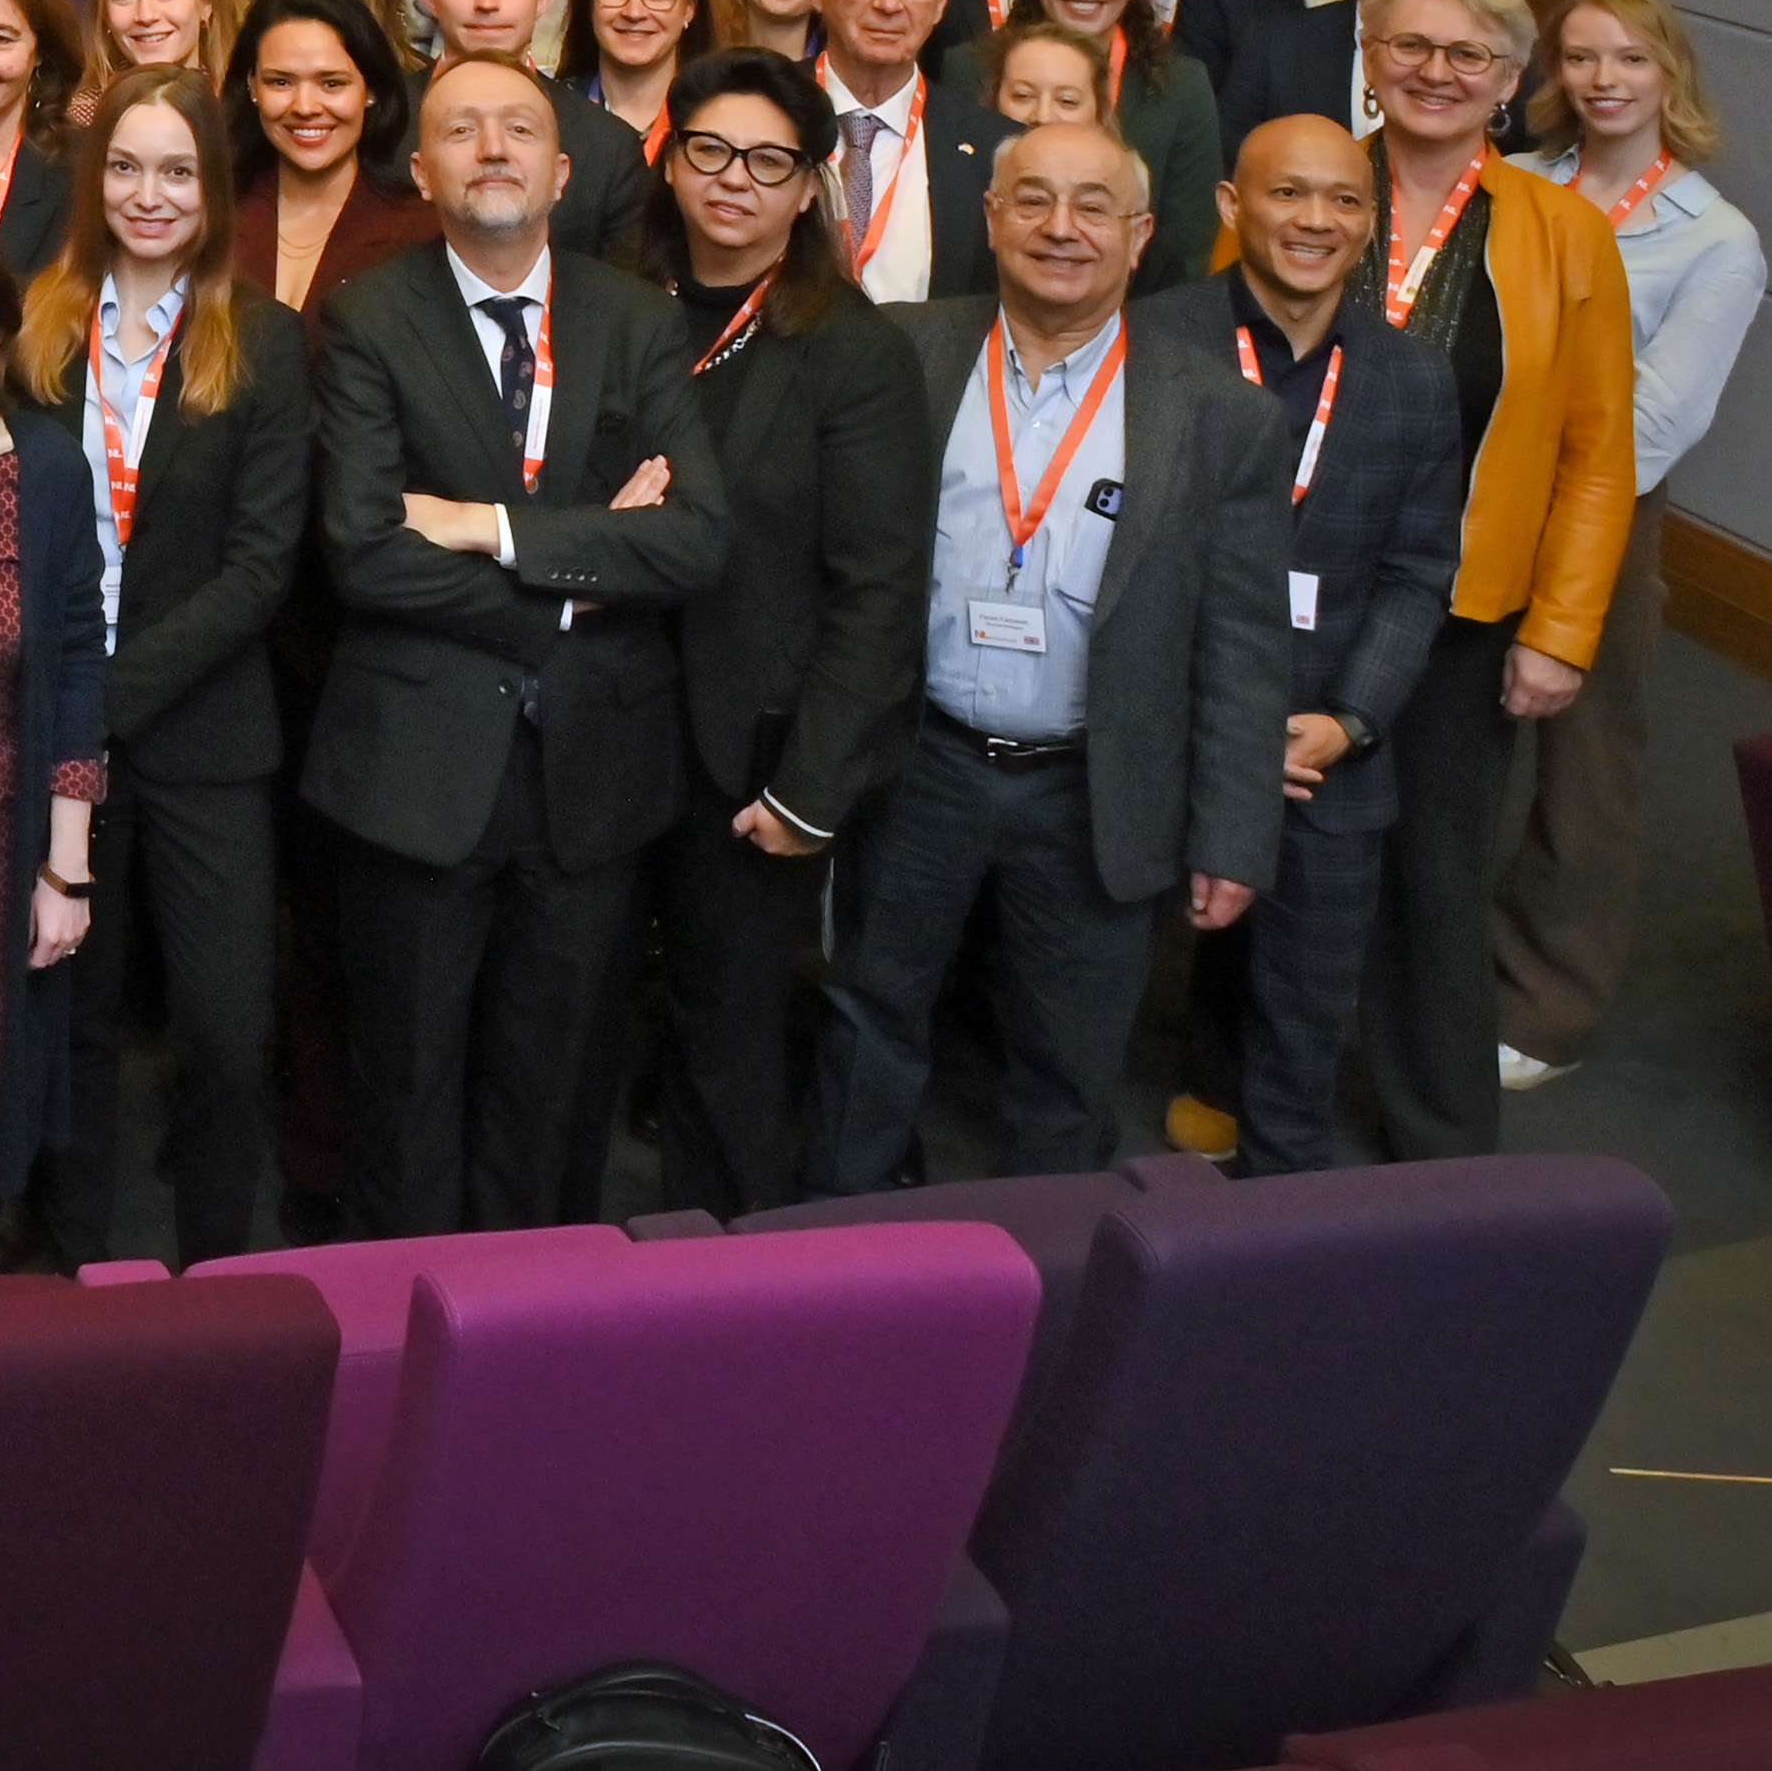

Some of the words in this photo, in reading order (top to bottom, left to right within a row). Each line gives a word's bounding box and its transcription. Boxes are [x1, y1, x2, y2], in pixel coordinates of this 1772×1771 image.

[1430, 228, 1443, 238] NL
[145, 372, 157, 382] NL
[108, 448, 123, 458] NL
[124, 482, 137, 492] NL
